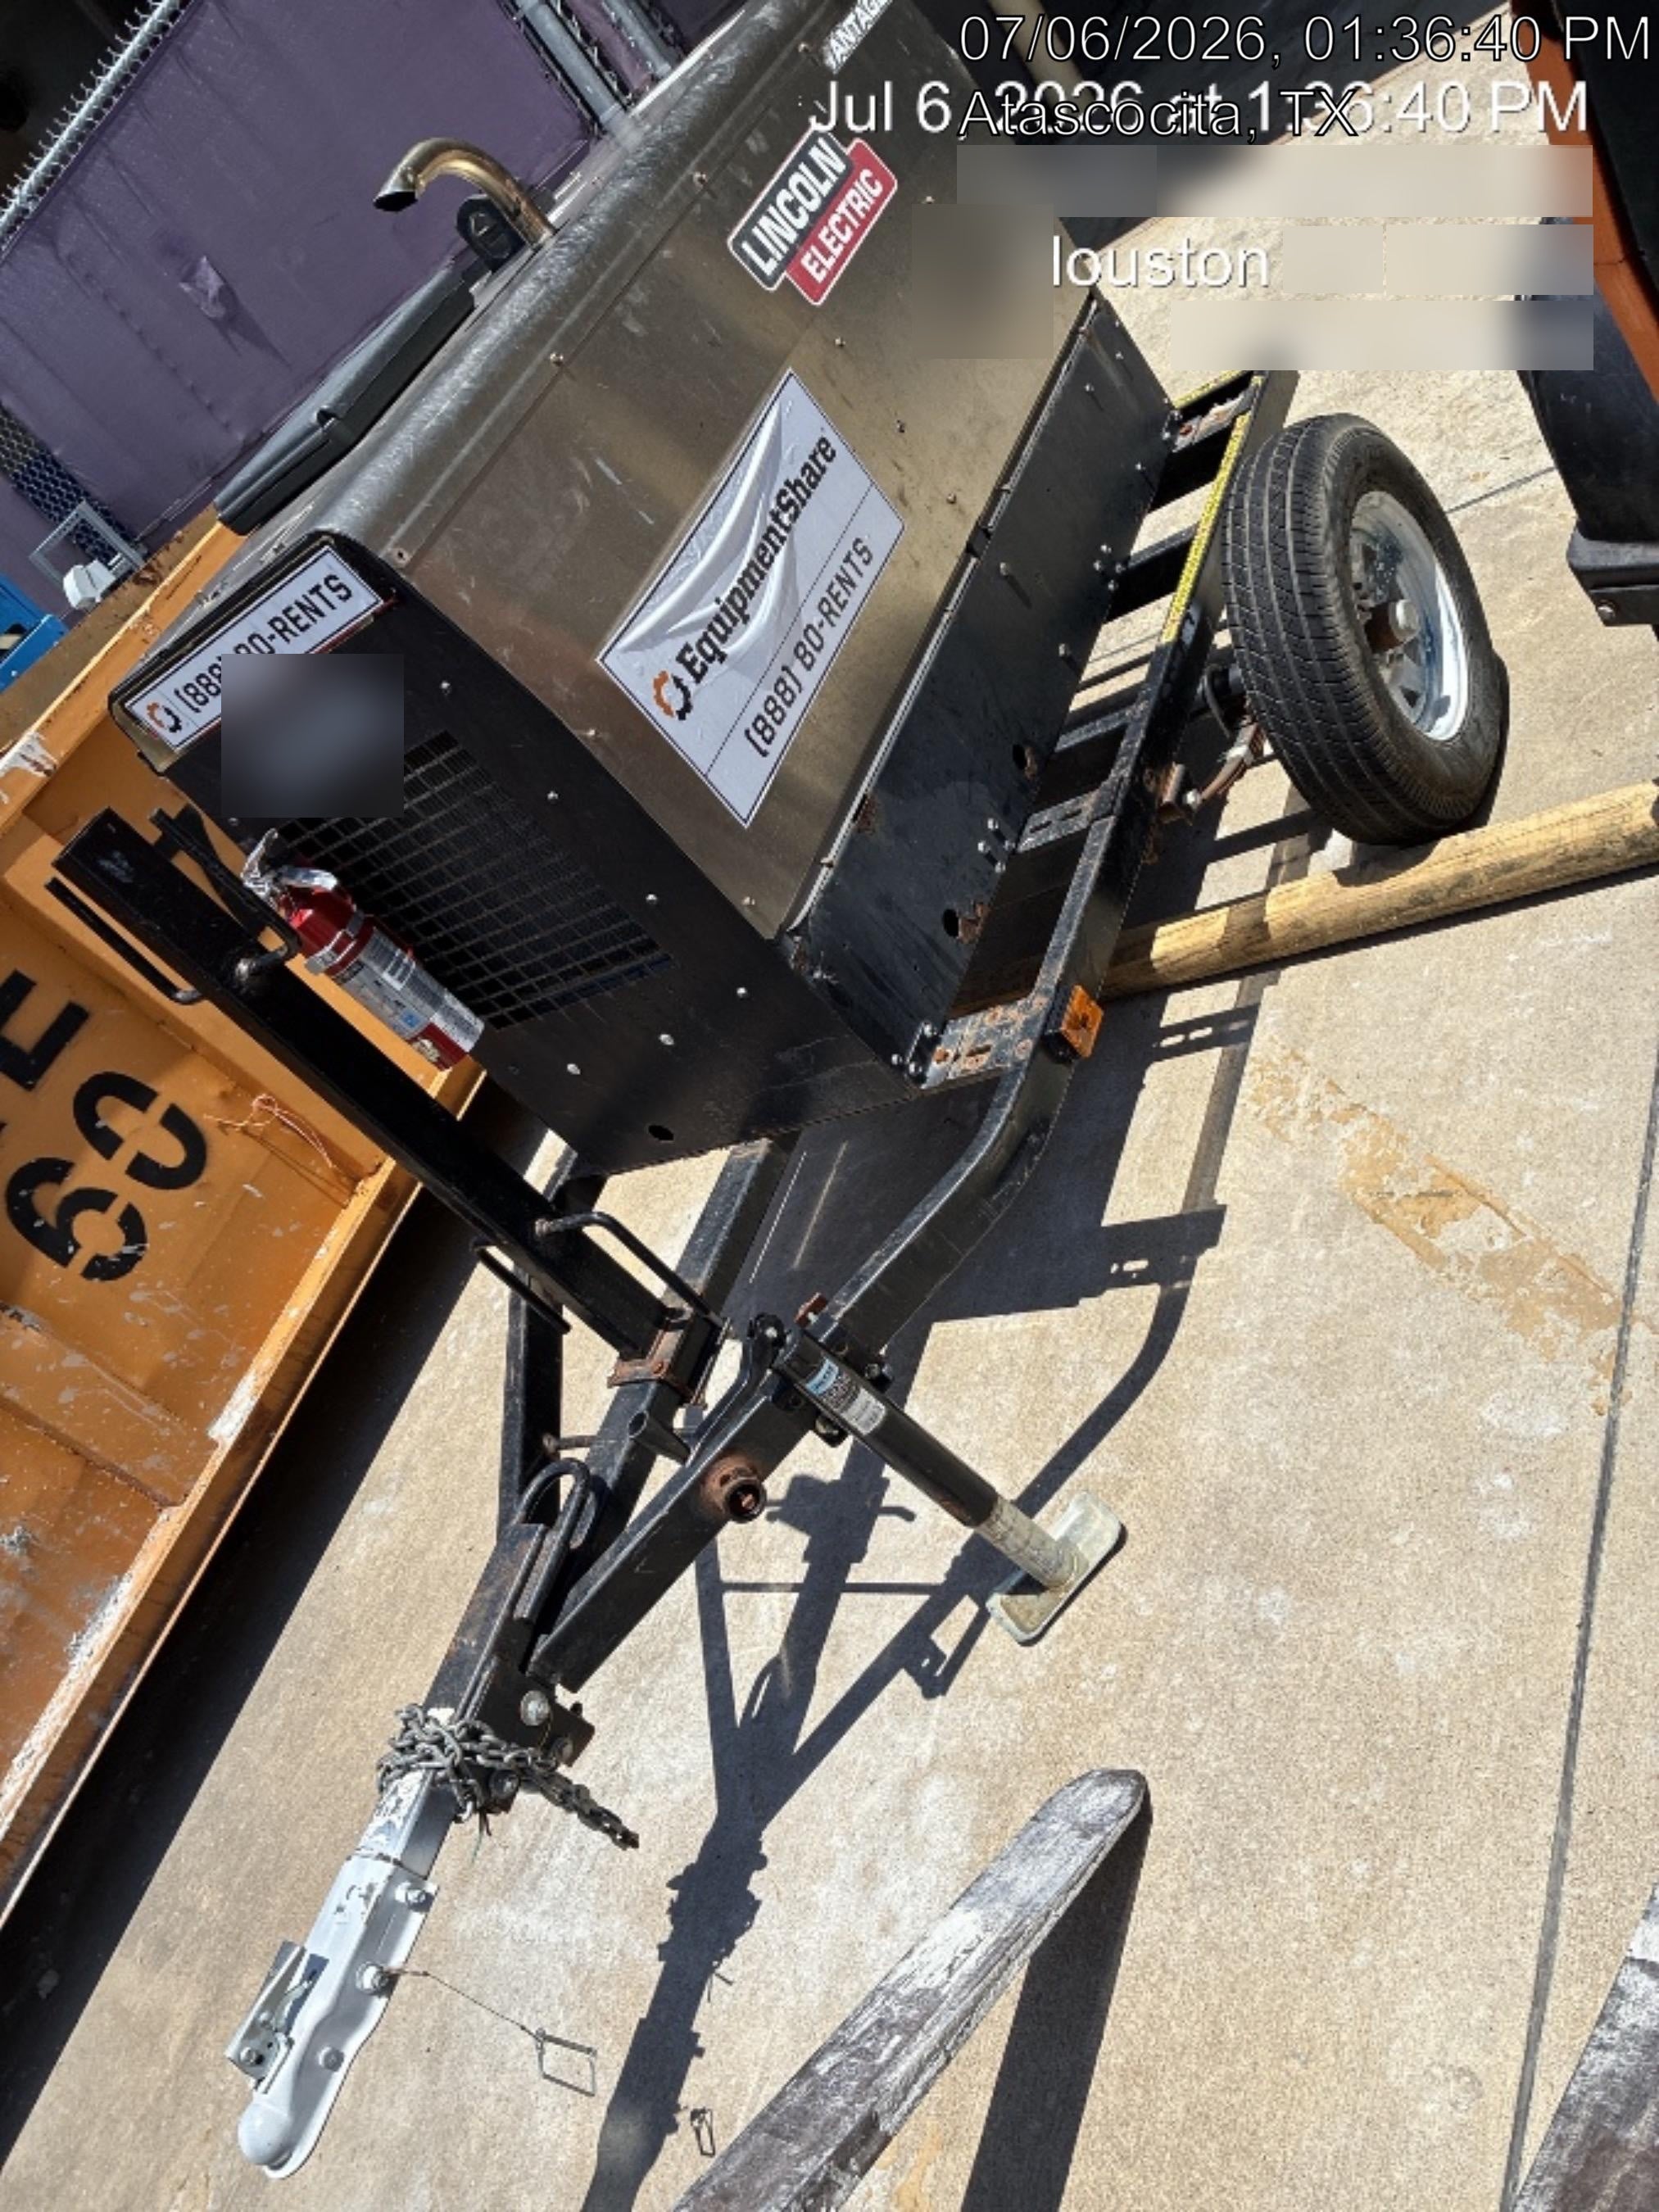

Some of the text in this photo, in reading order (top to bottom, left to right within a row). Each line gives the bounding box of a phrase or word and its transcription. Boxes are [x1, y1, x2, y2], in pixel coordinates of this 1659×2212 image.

[741, 137, 846, 276] LINCOLN
[800, 168, 883, 283] ELECTRIC
[676, 436, 837, 687] EquipmentShare
[173, 655, 221, 714] (88
[744, 664, 804, 759] (888)
[7, 1072, 206, 1281] 60
